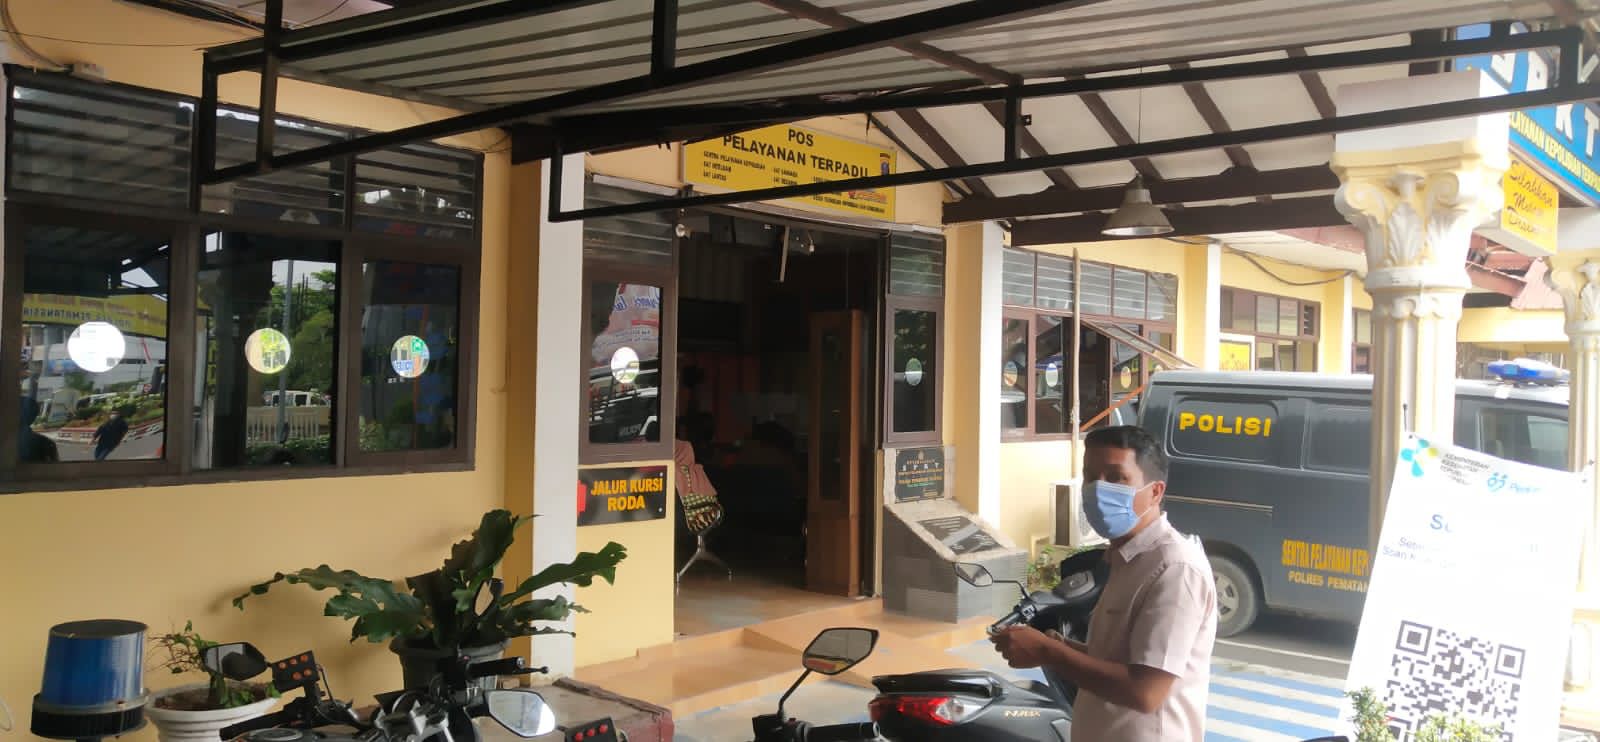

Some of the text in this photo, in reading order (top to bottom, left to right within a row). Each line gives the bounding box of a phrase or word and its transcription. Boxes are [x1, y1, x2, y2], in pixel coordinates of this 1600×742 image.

[788, 128, 814, 147] POS
[723, 135, 868, 178] PELAYANAN TERPADU
[1179, 412, 1272, 438] POLISI
[591, 478, 663, 496] JALUR KURSI
[607, 496, 646, 512] RODA
[1288, 570, 1324, 587] POLRES
